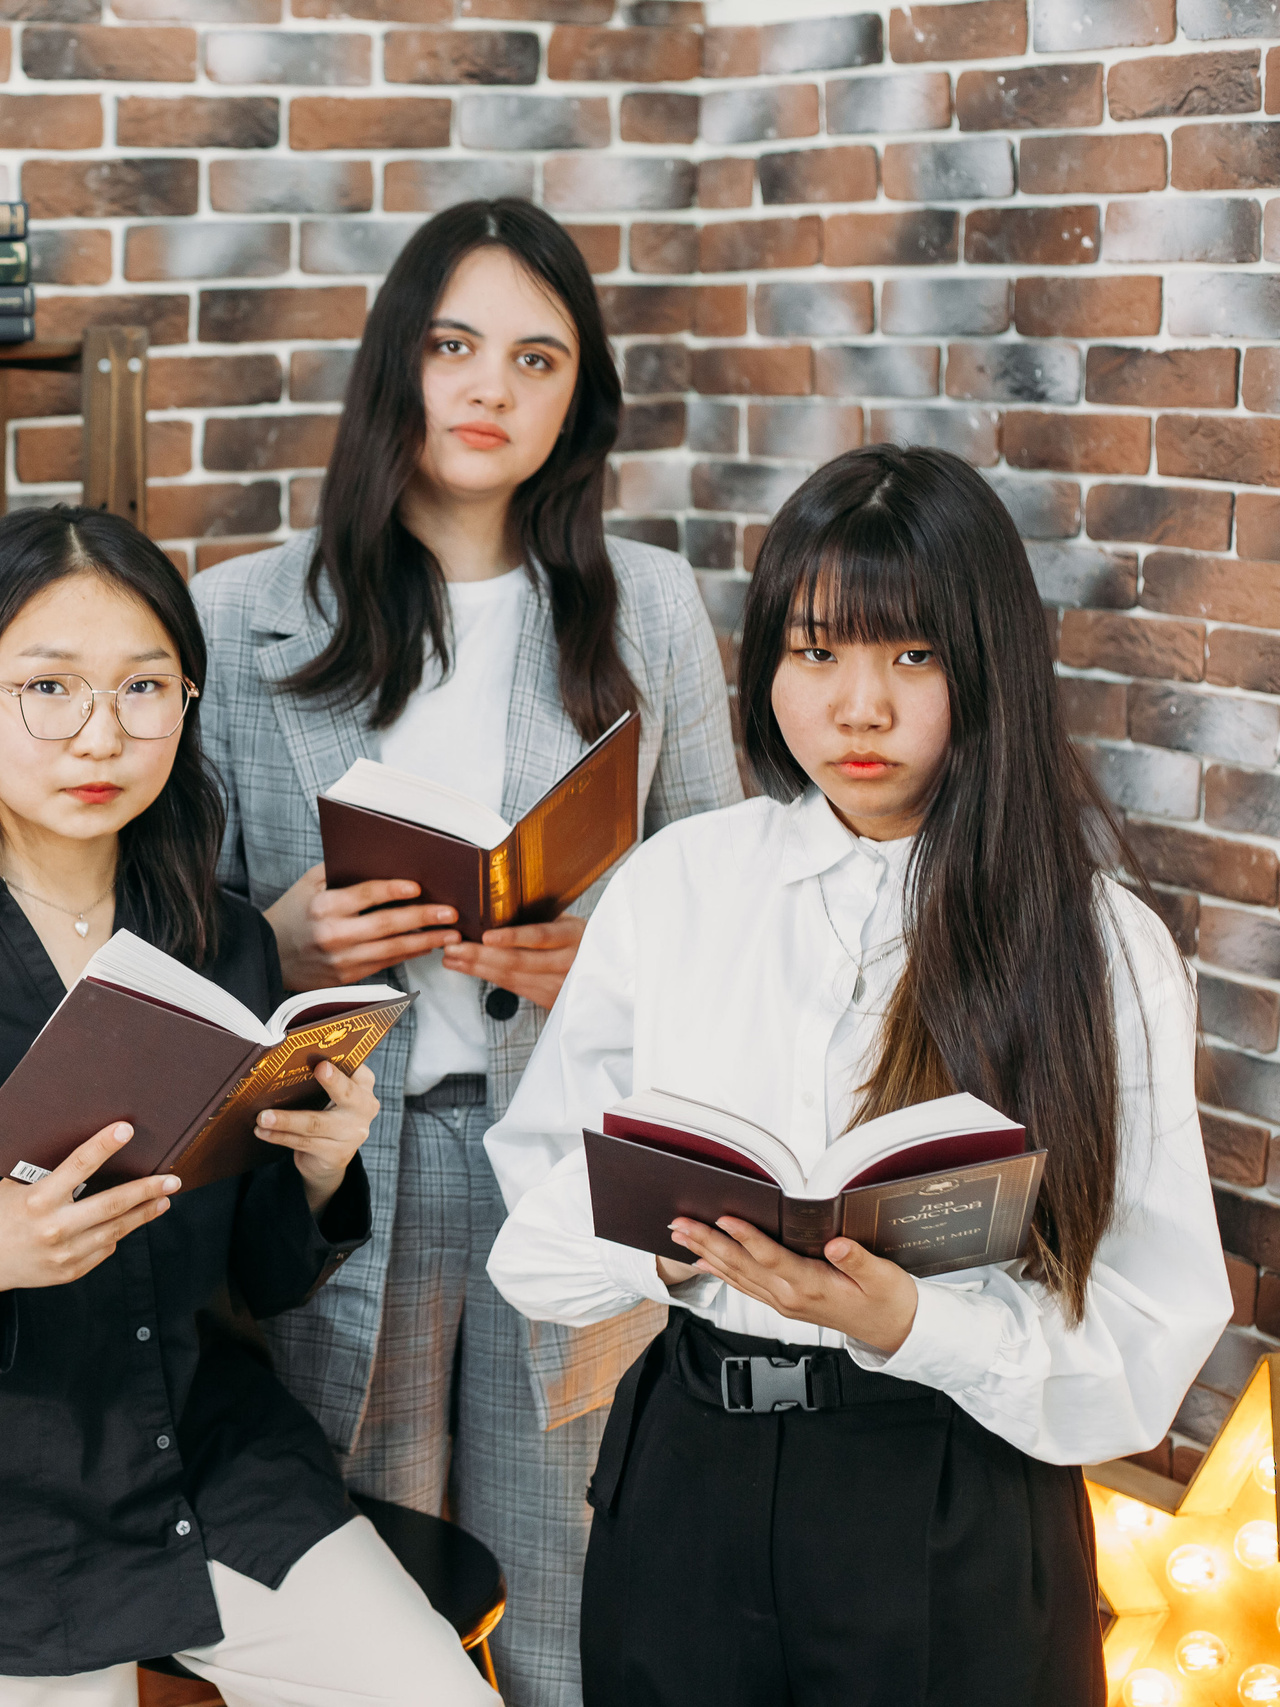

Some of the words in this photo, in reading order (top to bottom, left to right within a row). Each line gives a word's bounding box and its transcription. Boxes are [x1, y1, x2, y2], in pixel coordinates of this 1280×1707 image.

[888, 1200, 983, 1226] ТОЛСТОЙ
[920, 1200, 955, 1213] Лев
[950, 1227, 982, 1239] МИР
